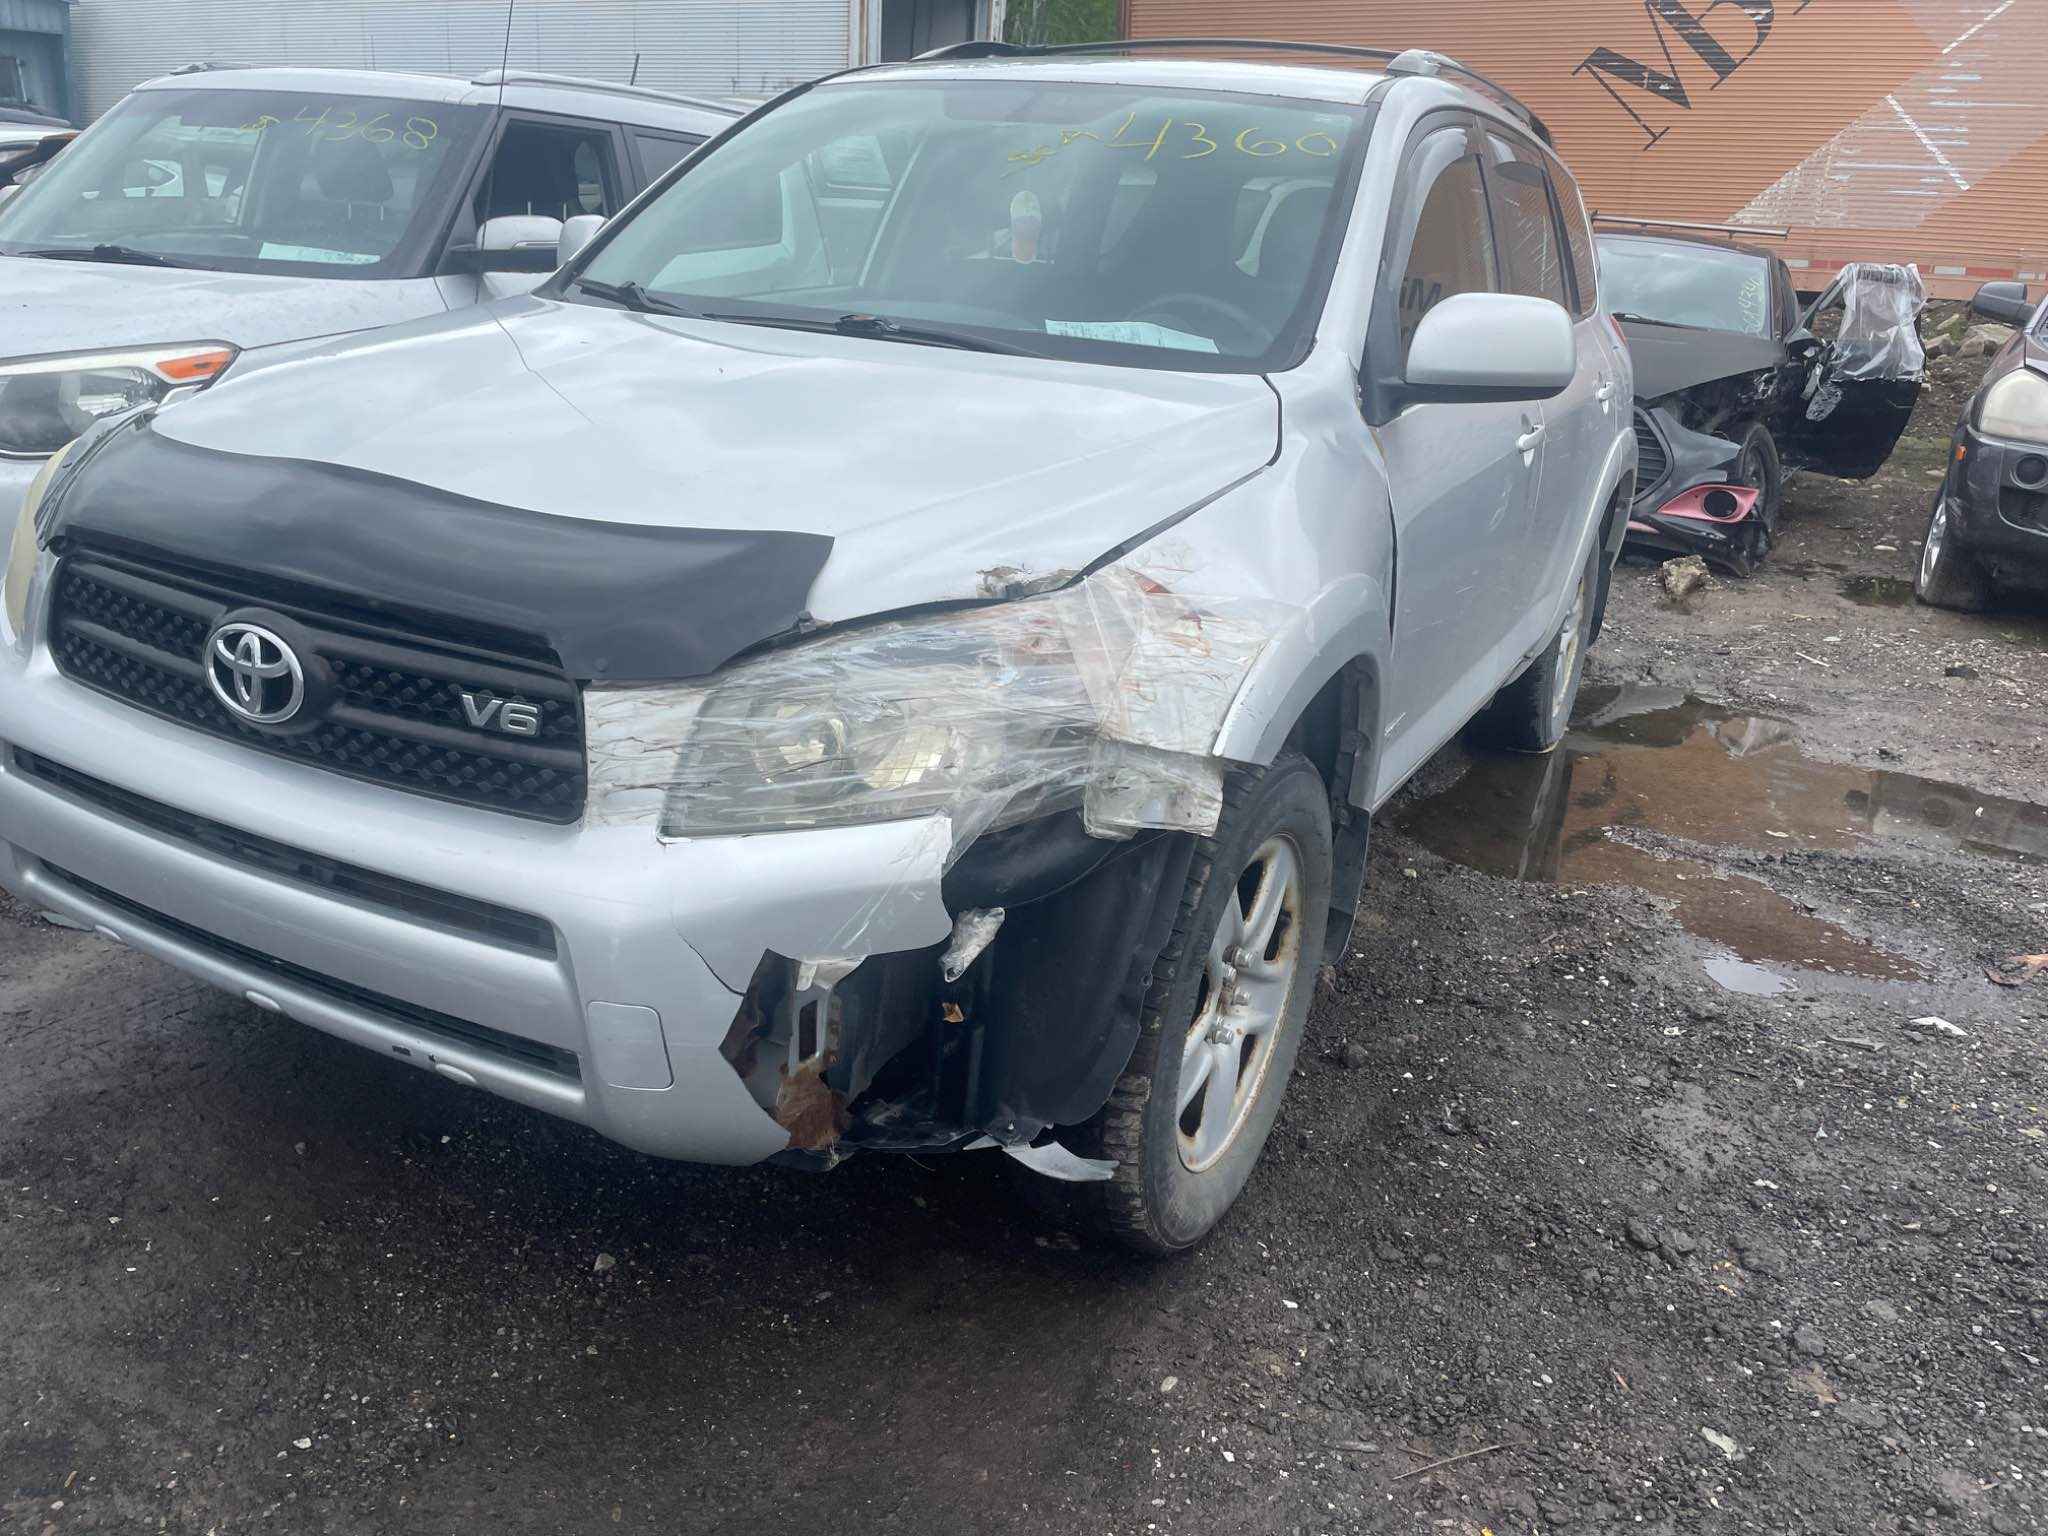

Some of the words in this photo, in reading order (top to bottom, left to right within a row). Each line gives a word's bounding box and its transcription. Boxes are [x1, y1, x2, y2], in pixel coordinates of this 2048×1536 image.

[293, 105, 437, 149] 4368
[1104, 111, 1337, 161] 4360
[461, 694, 538, 736] V6
